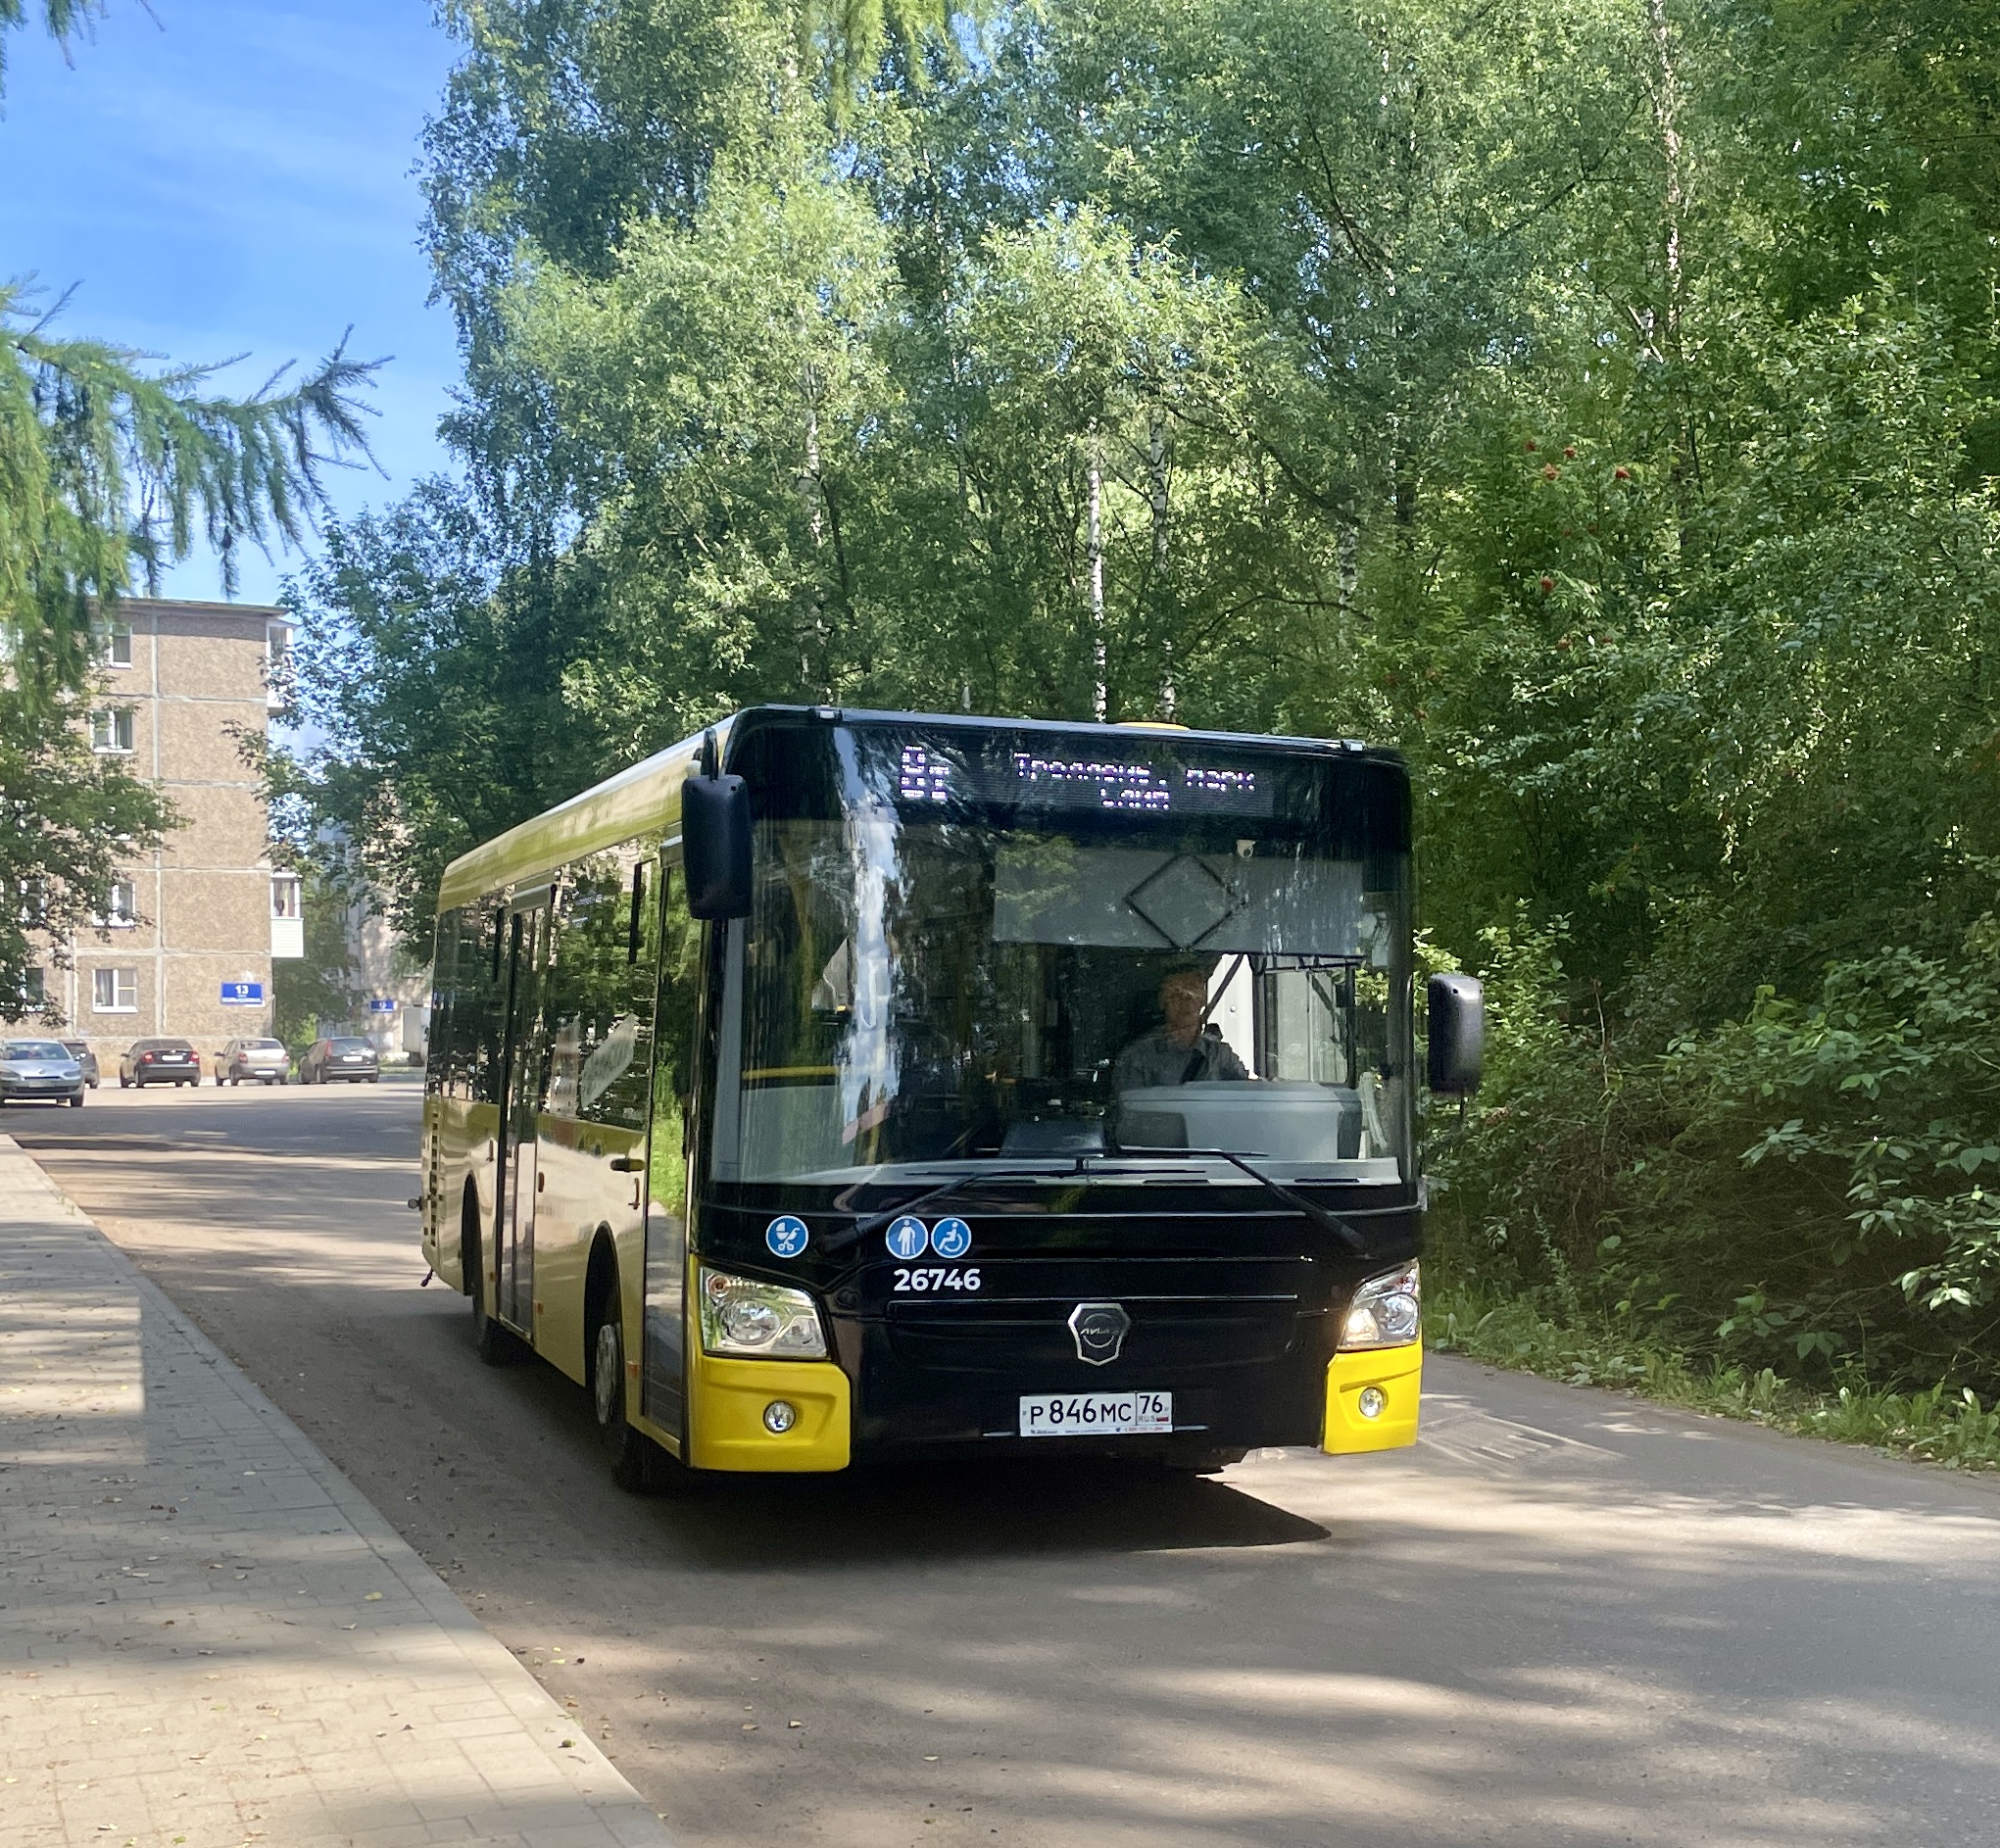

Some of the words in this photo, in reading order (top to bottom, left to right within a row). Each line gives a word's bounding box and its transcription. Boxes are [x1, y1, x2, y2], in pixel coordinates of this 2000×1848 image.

[235, 985, 249, 995] 13
[894, 1268, 981, 1290] 26746
[1139, 1395, 1163, 1414] 76
